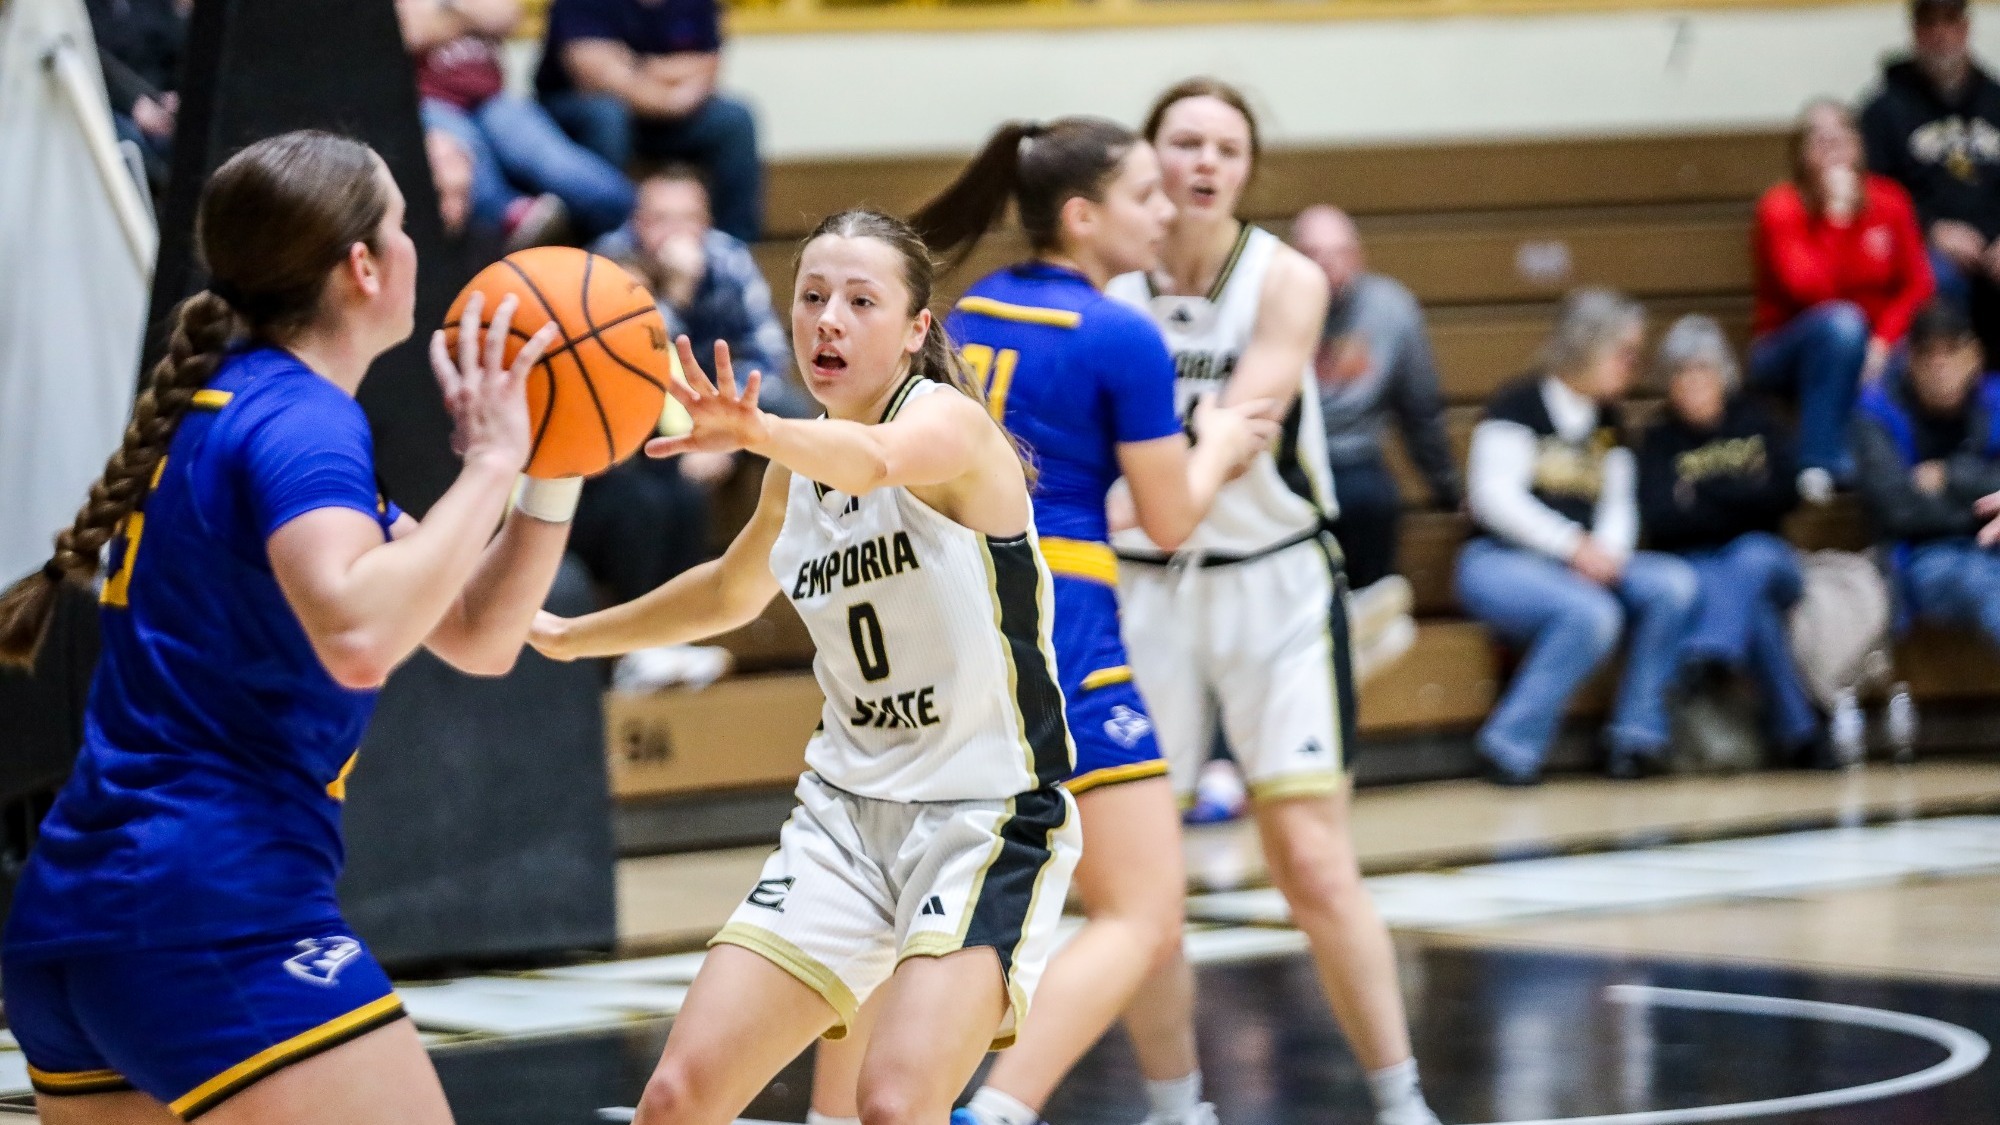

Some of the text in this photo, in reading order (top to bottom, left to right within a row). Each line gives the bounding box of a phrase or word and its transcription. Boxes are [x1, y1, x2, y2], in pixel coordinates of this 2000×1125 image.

[792, 530, 919, 600] EMPORIA
[848, 601, 890, 682] 0
[850, 685, 941, 729] STATE
